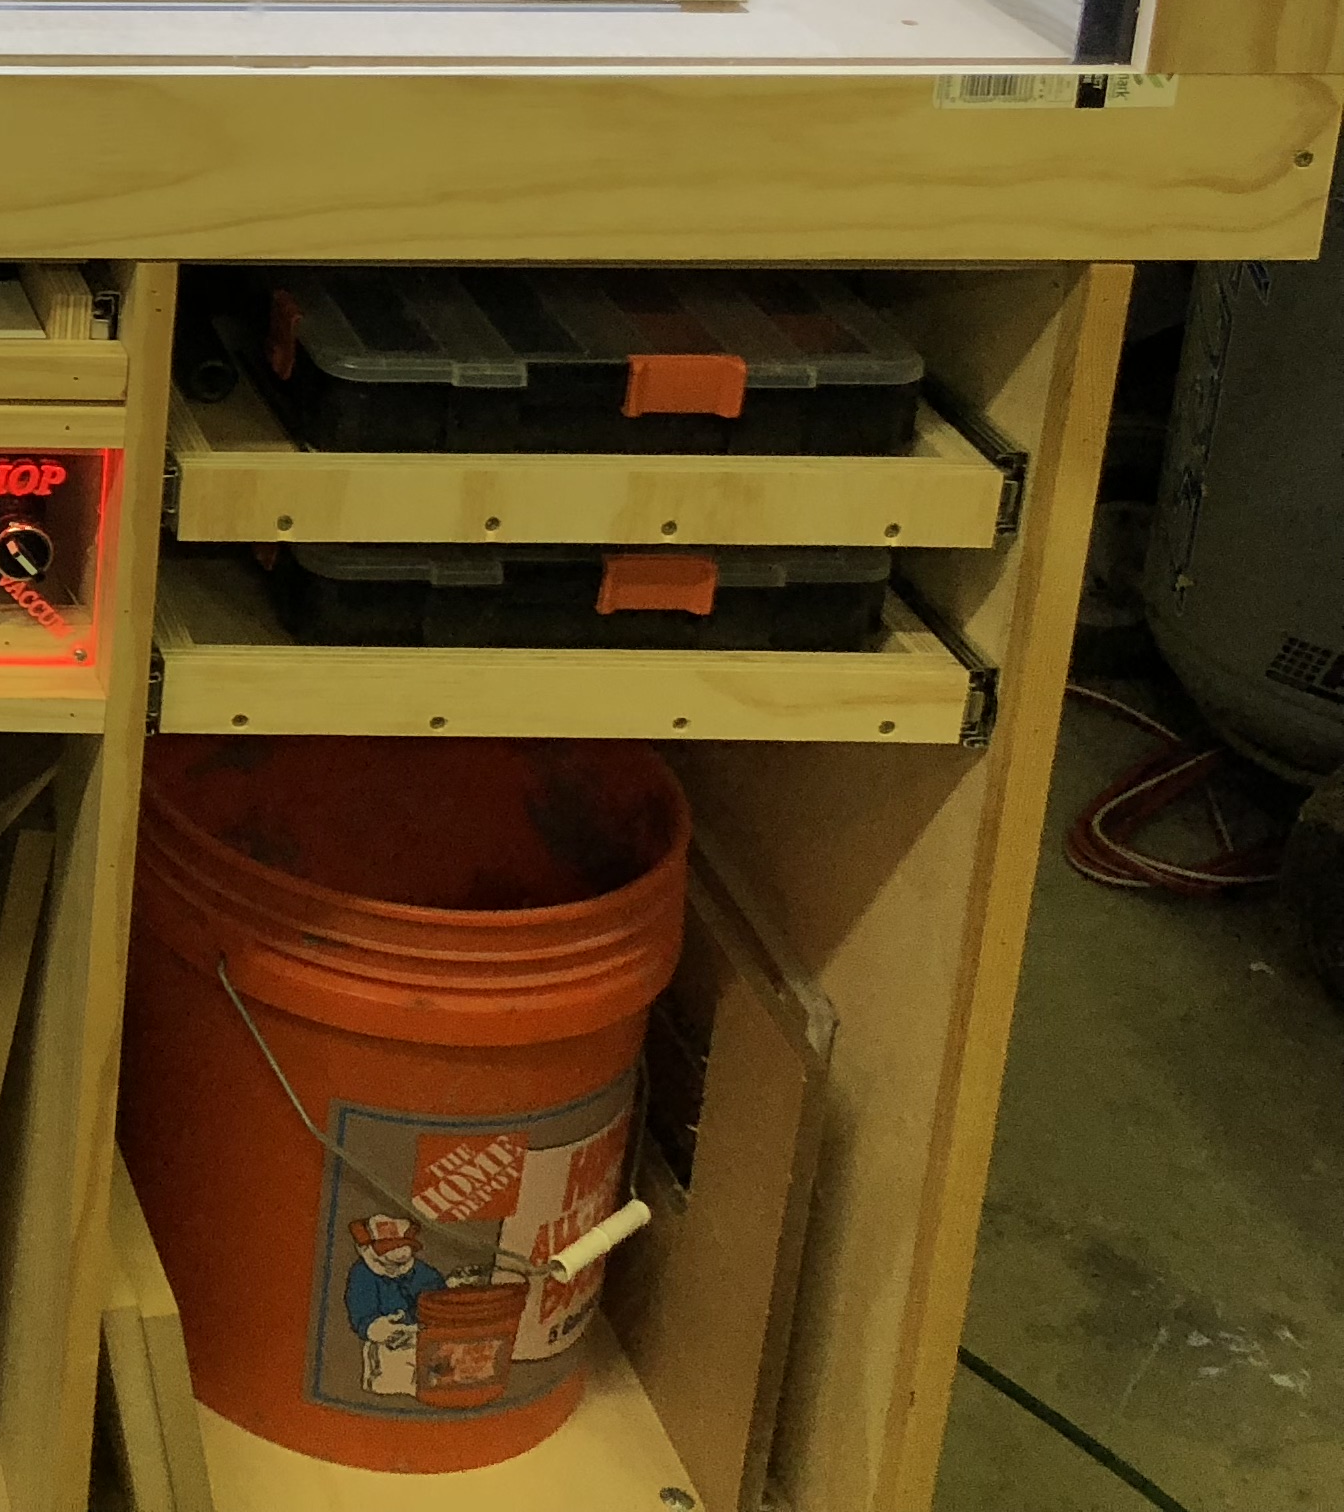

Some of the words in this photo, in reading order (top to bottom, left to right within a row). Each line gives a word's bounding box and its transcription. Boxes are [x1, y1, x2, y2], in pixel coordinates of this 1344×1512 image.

[412, 1135, 525, 1220] HOME
[426, 1142, 476, 1179] THE
[450, 1164, 520, 1221] DEPOT
